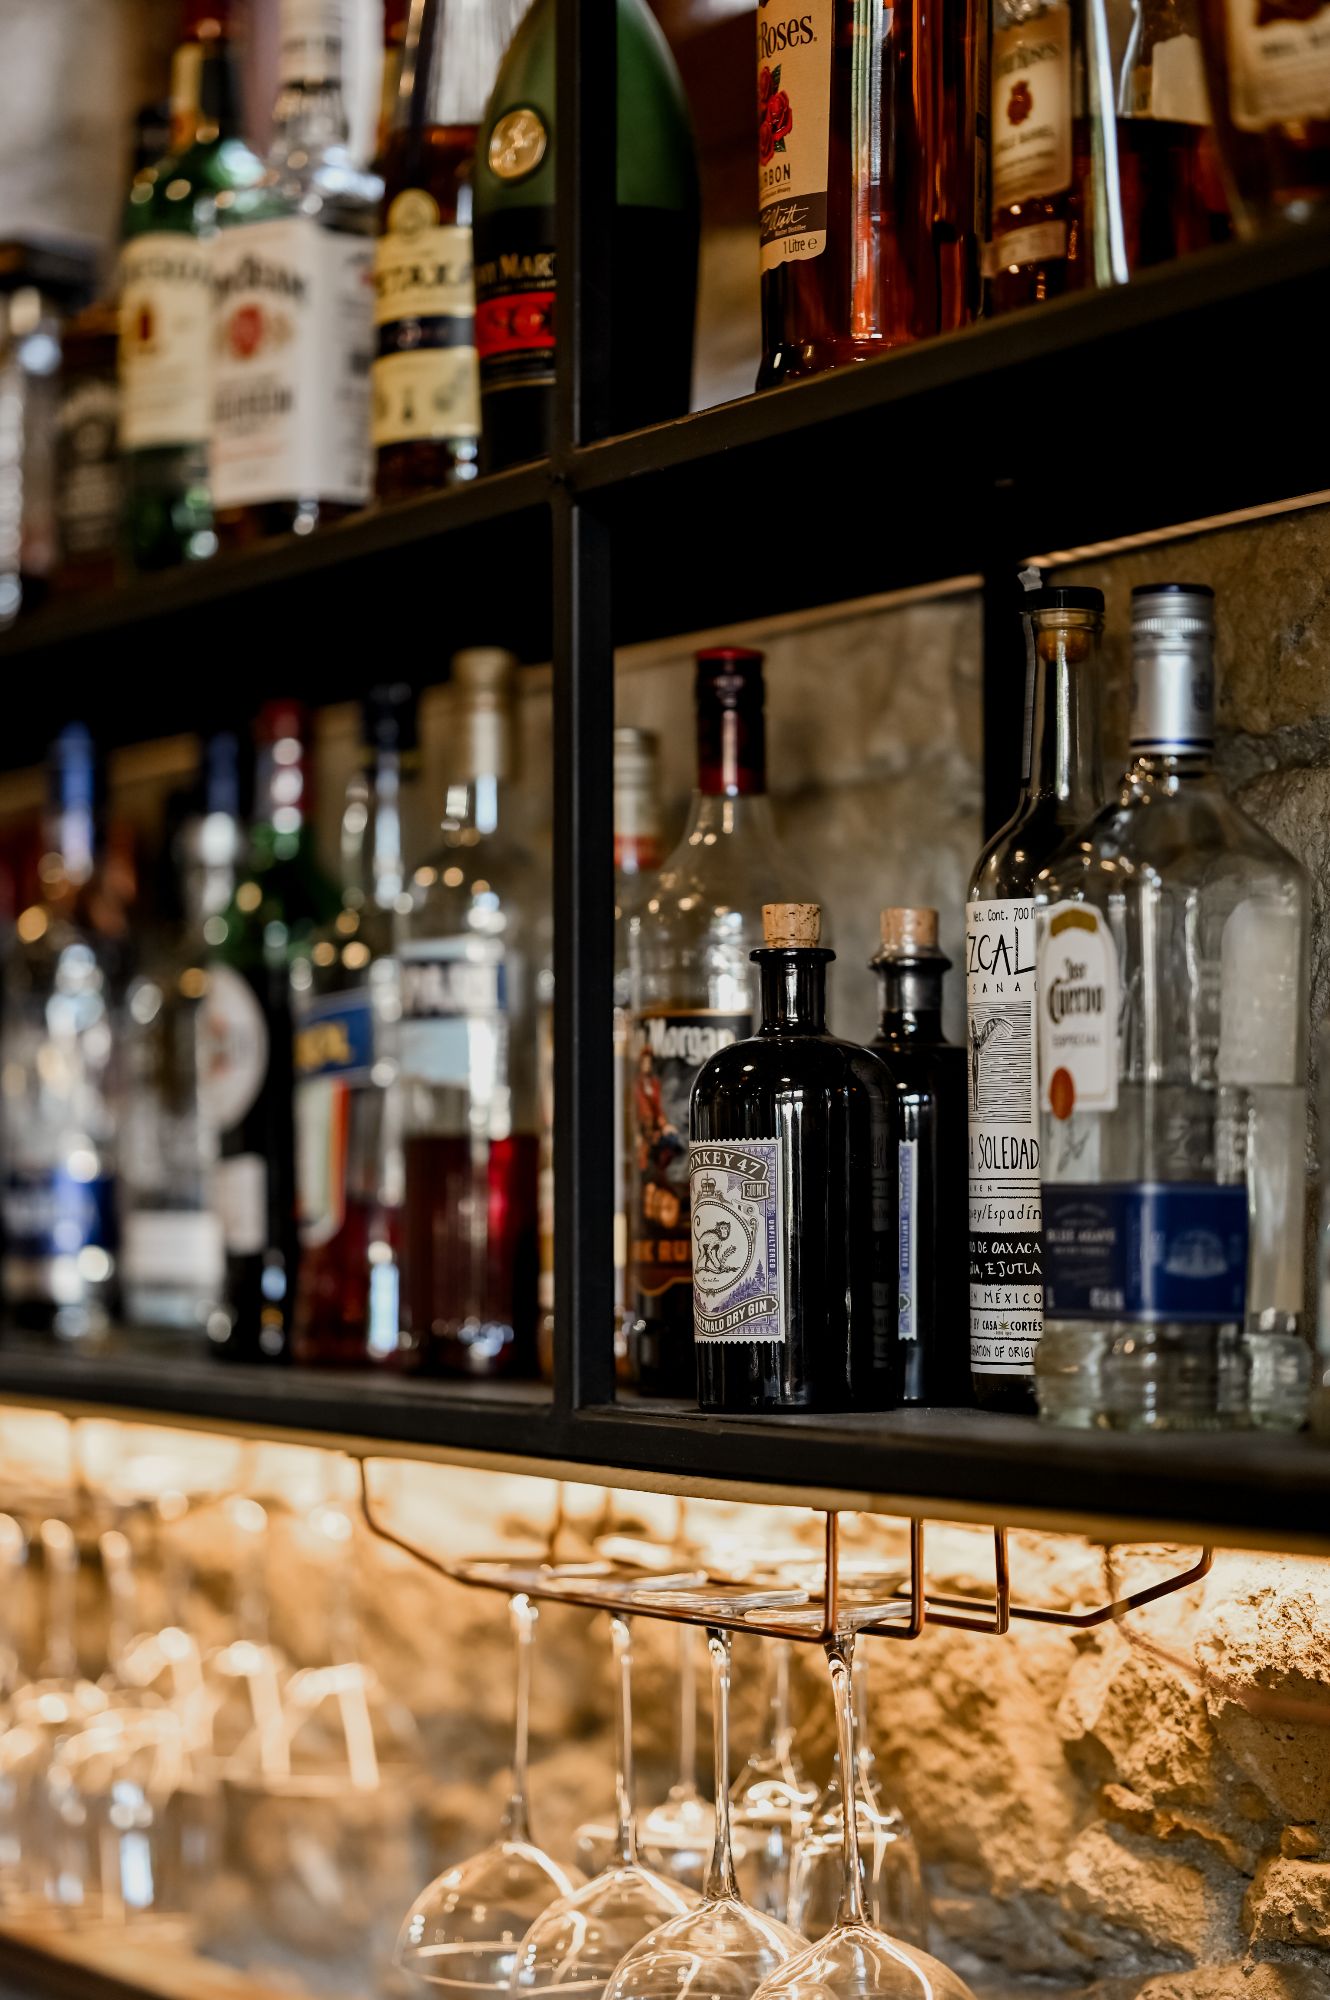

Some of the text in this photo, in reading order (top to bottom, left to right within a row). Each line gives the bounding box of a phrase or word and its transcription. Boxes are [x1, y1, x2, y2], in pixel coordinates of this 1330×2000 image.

[788, 238, 806, 253] Litre
[988, 908, 1009, 921] Cont.
[1013, 907, 1029, 922] 700
[967, 926, 1037, 977] ZCAL
[647, 1018, 737, 1066] Morgan
[978, 1133, 1040, 1172] SOLEDAD
[737, 1158, 761, 1174] 47
[746, 1184, 764, 1197] 500 ML
[768, 1219, 776, 1268] UNFILTERED
[991, 1241, 1042, 1254] OAXACA
[984, 1287, 1042, 1304] MÉXICO
[726, 1307, 746, 1327] DRY
[747, 1300, 767, 1316] GIN
[974, 1318, 1044, 1332] BY CASA CORTÉS
[995, 1346, 1005, 1358] OF
